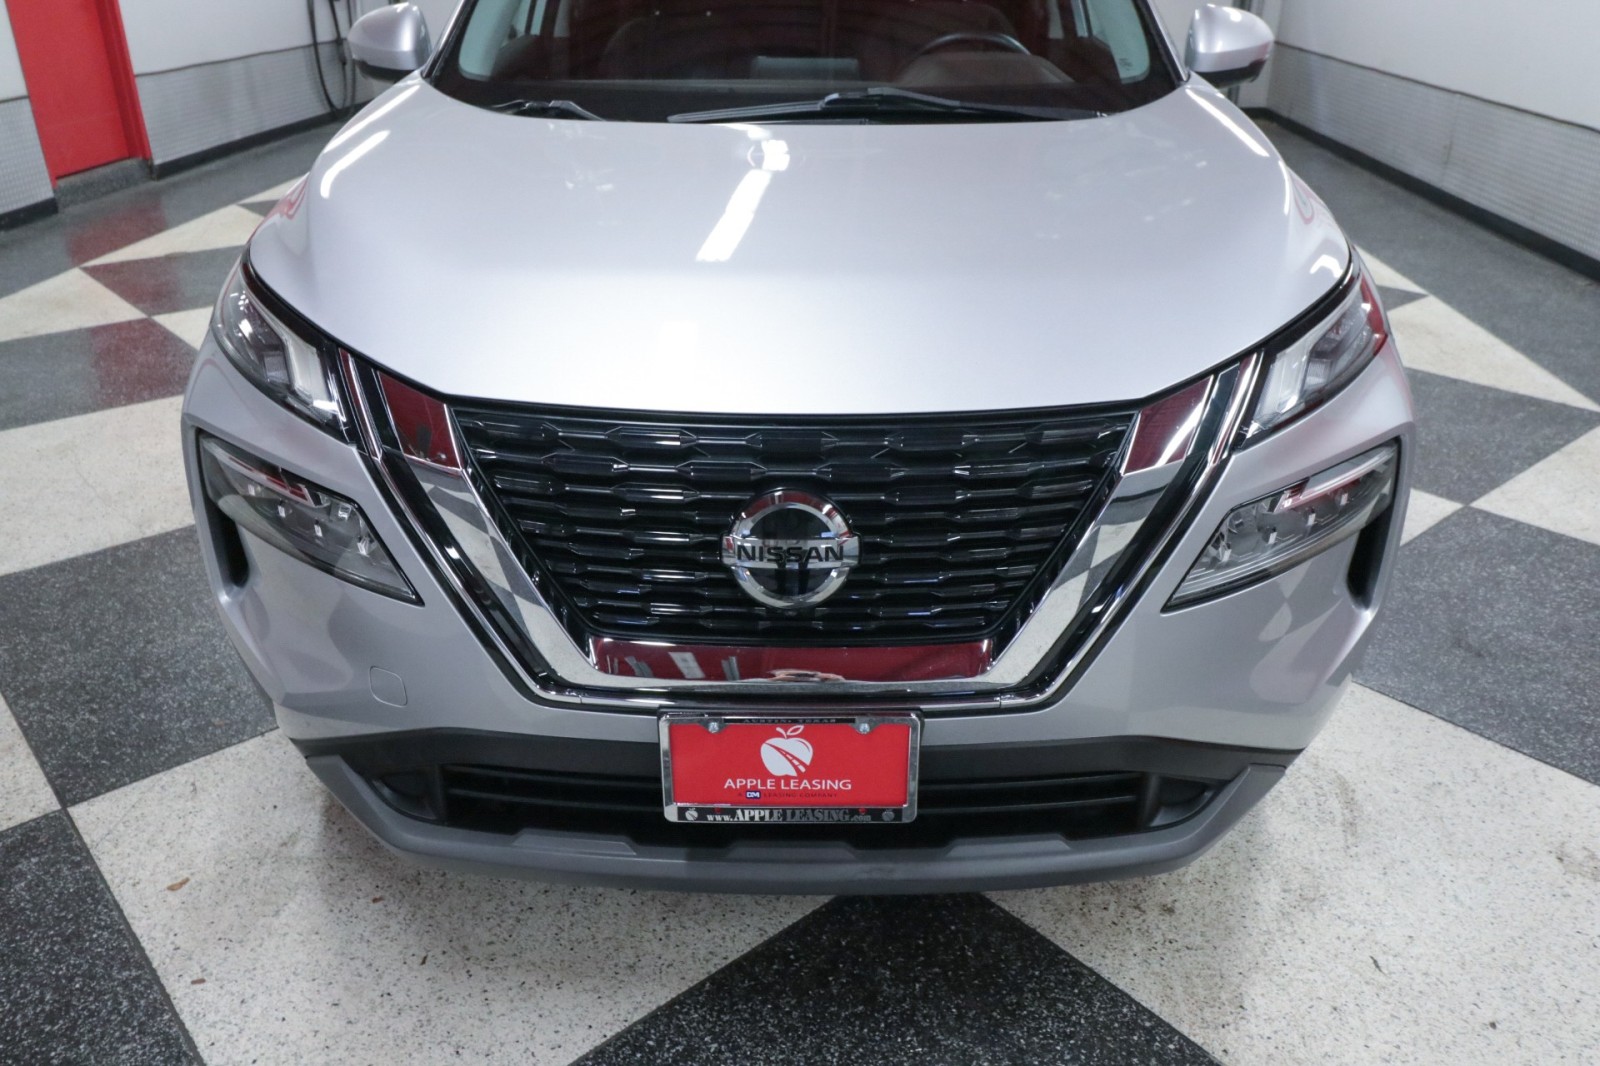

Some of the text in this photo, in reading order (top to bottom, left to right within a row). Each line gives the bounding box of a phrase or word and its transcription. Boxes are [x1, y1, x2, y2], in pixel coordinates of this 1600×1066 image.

[737, 545, 844, 562] NISSAN
[724, 779, 852, 790] APPLE LEASING
